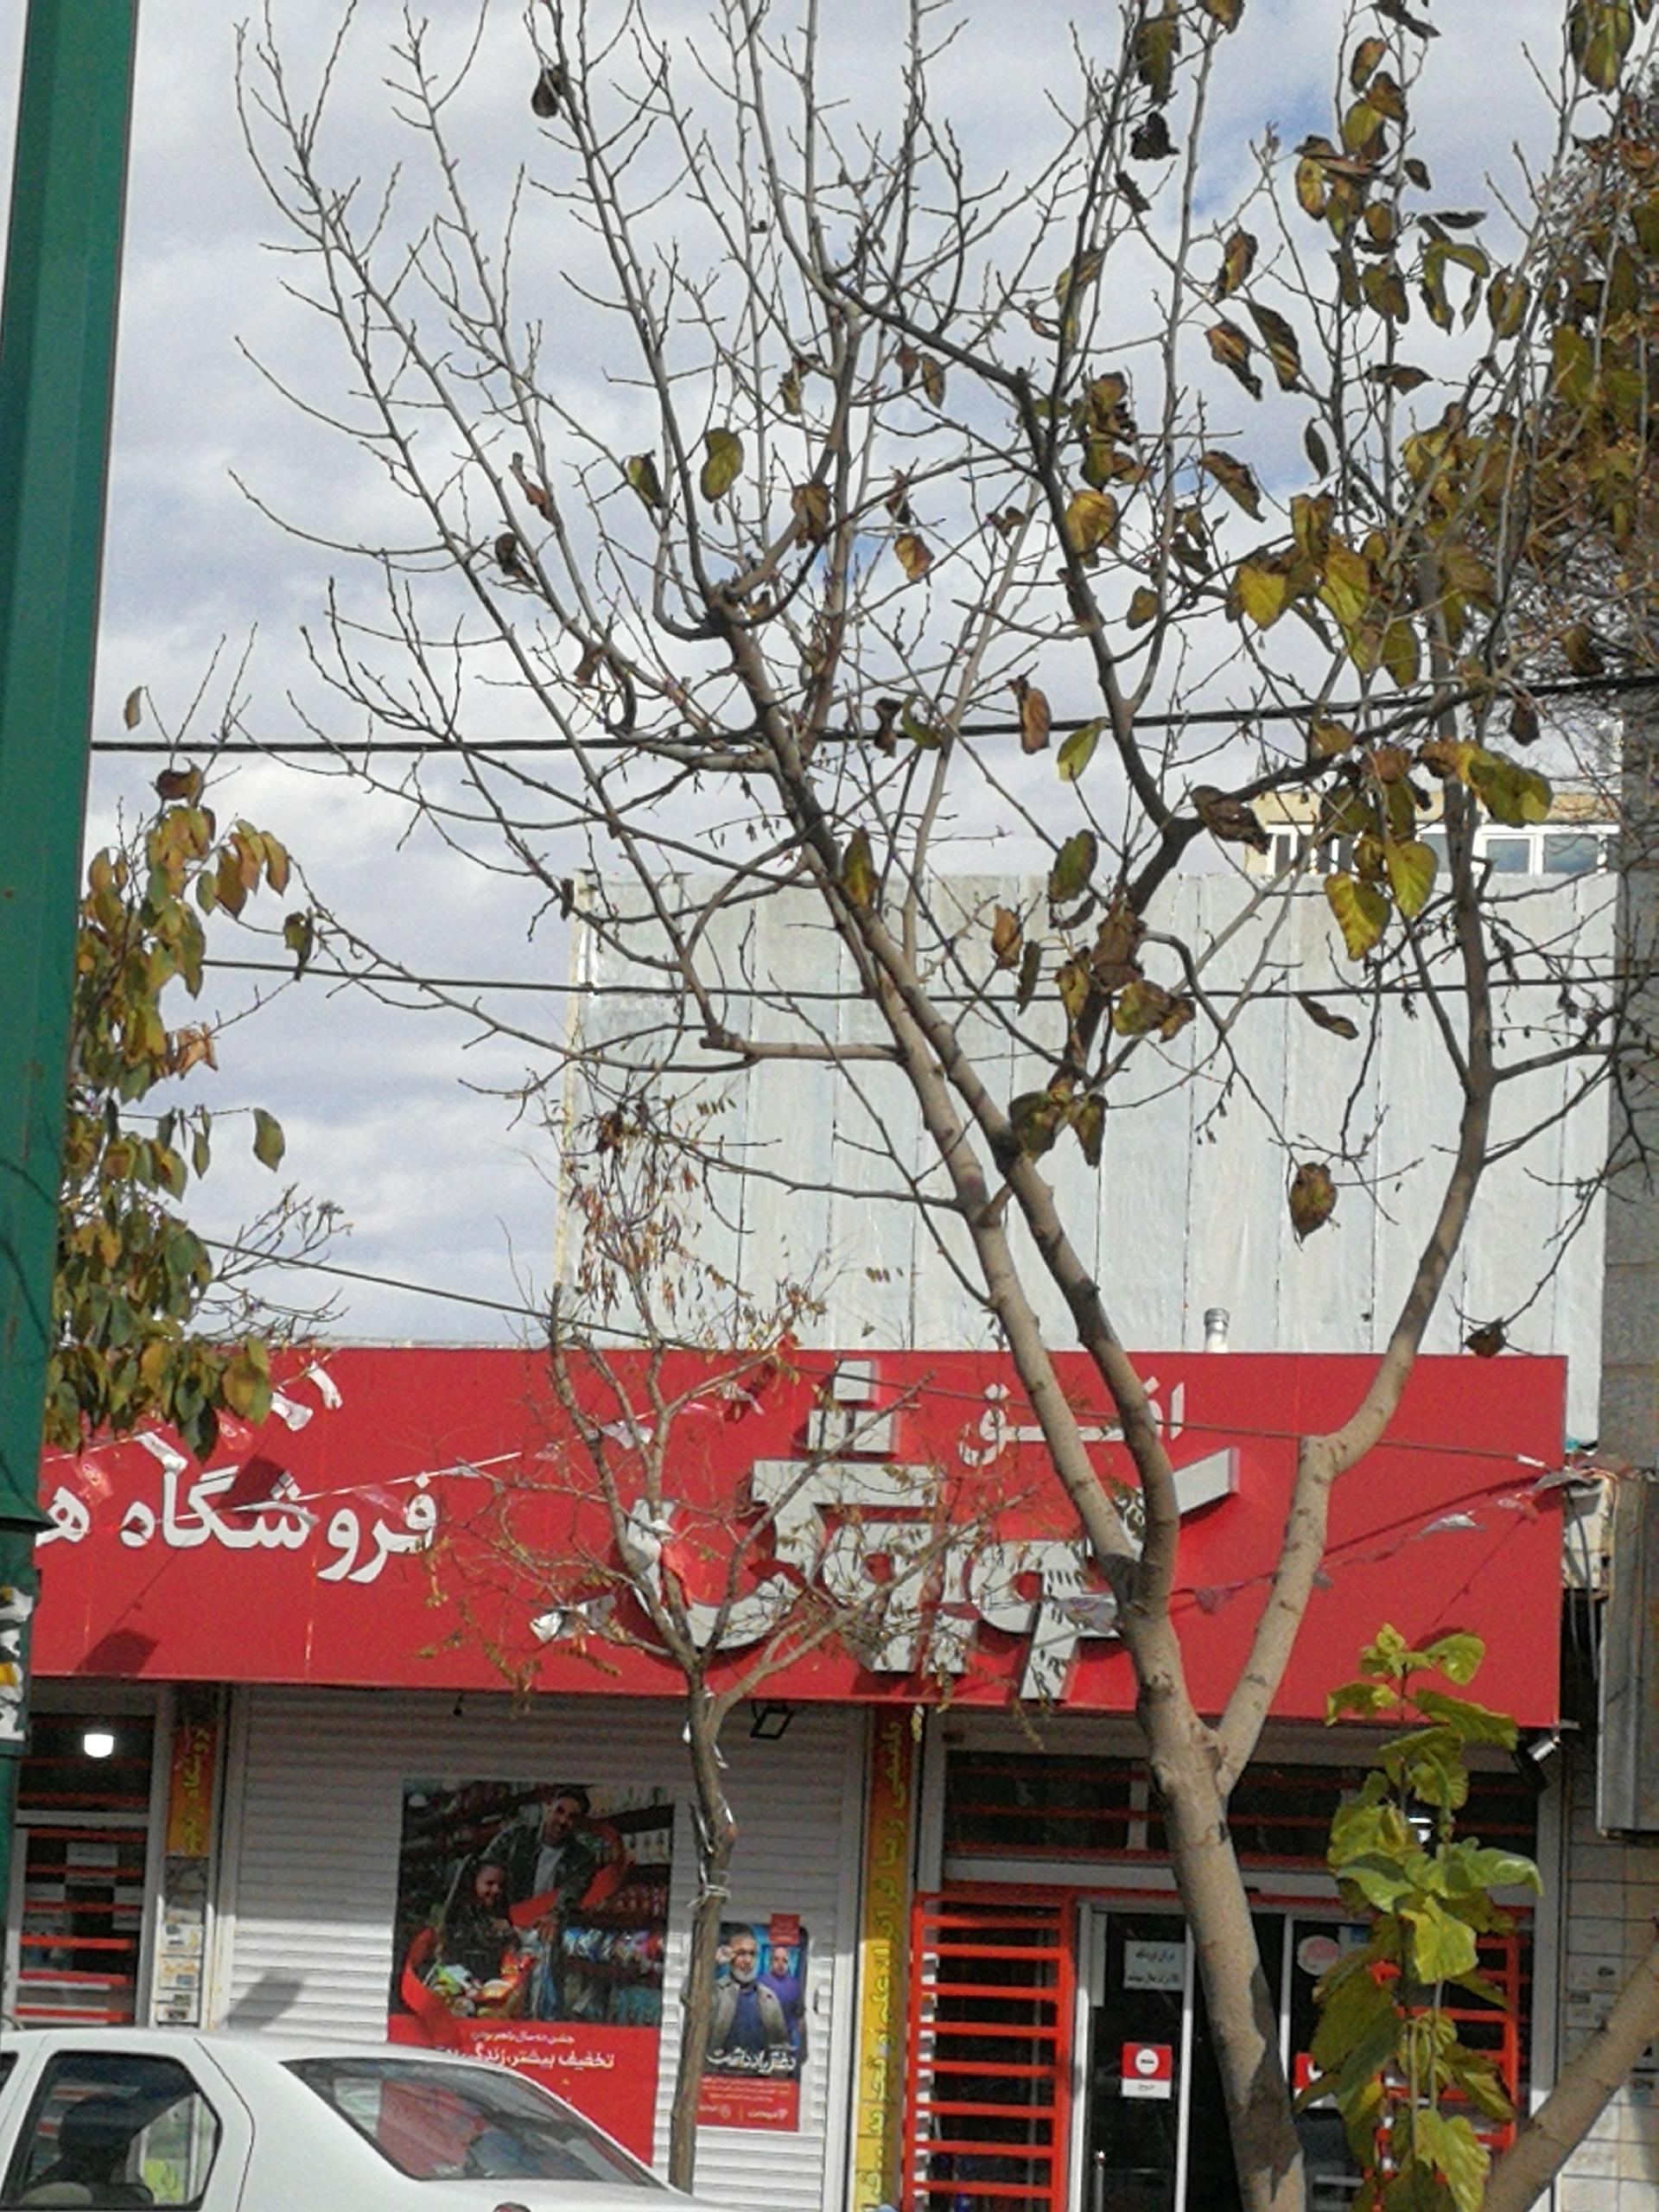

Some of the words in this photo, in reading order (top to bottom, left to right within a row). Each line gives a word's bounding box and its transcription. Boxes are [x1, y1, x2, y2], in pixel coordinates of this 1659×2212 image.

[119, 1465, 437, 1584] فروشگاه
[471, 2042, 506, 2065] زندگ
[558, 2050, 614, 2070] تخفیف
[706, 2046, 768, 2069] یادداشت
